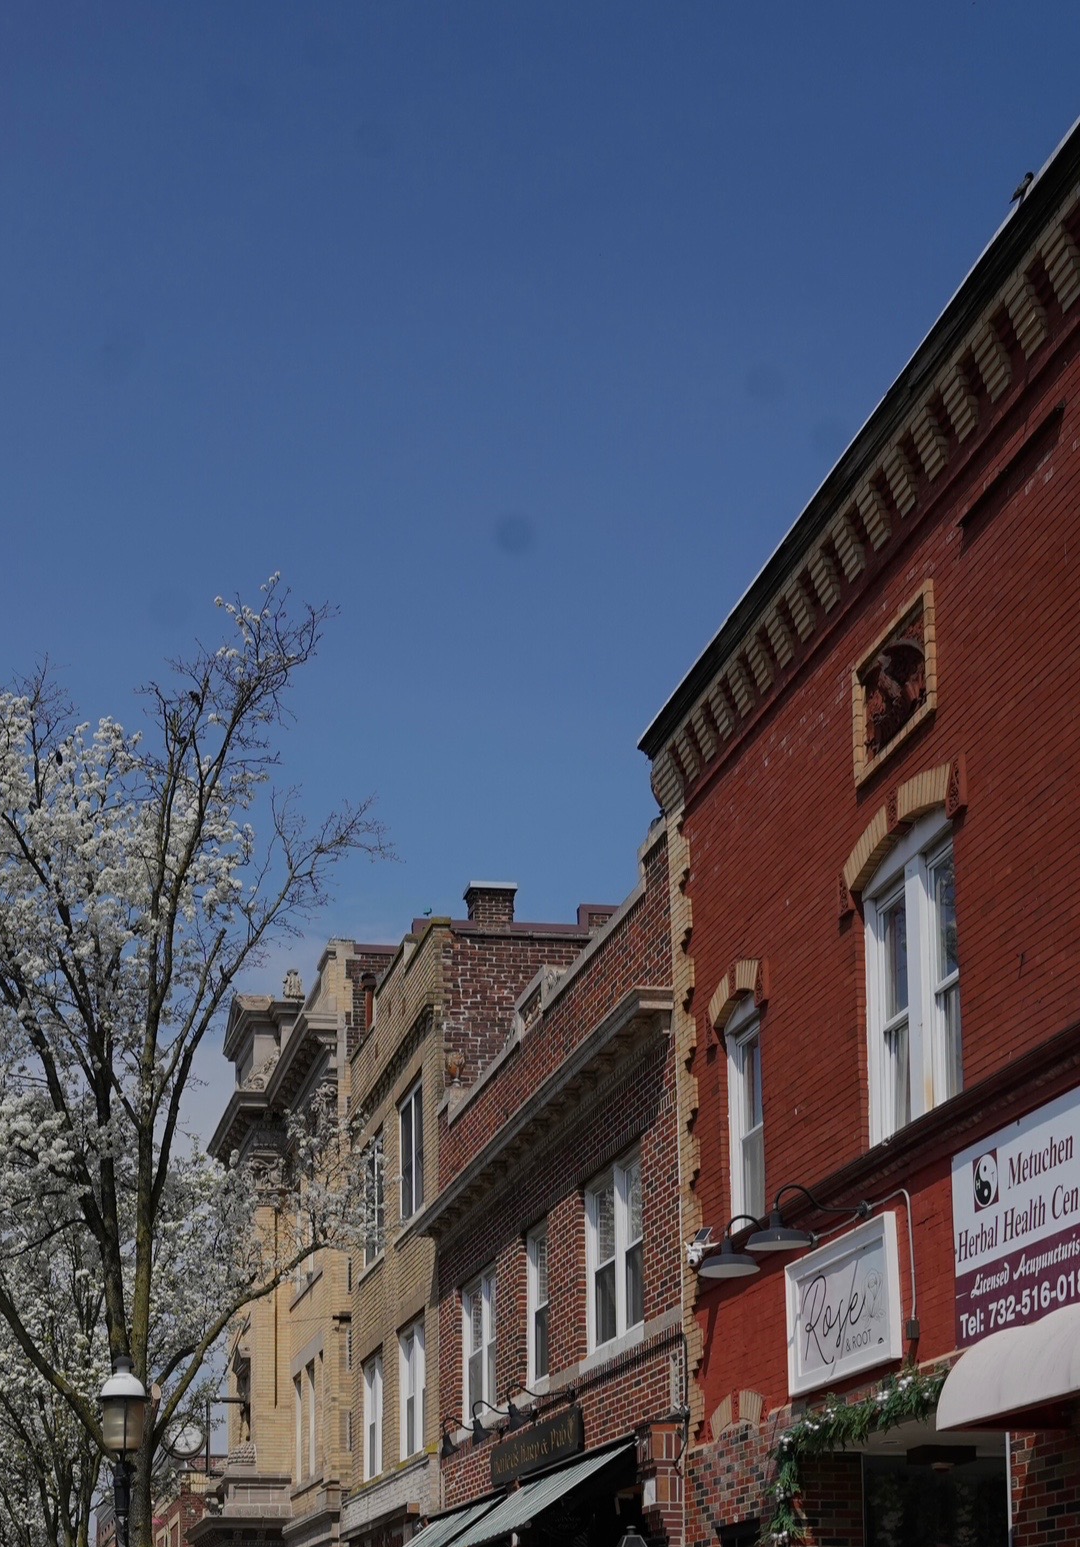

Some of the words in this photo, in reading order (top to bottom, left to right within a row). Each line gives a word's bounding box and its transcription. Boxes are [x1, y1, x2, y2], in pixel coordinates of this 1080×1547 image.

[1008, 1135, 1073, 1190] Metuchen
[958, 1216, 998, 1263] Herbal
[1003, 1196, 1046, 1243] Health
[970, 1262, 1010, 1299] Licensed
[801, 1274, 866, 1365] Rose
[852, 1329, 872, 1349] ROOT
[960, 1308, 985, 1339] Tel:
